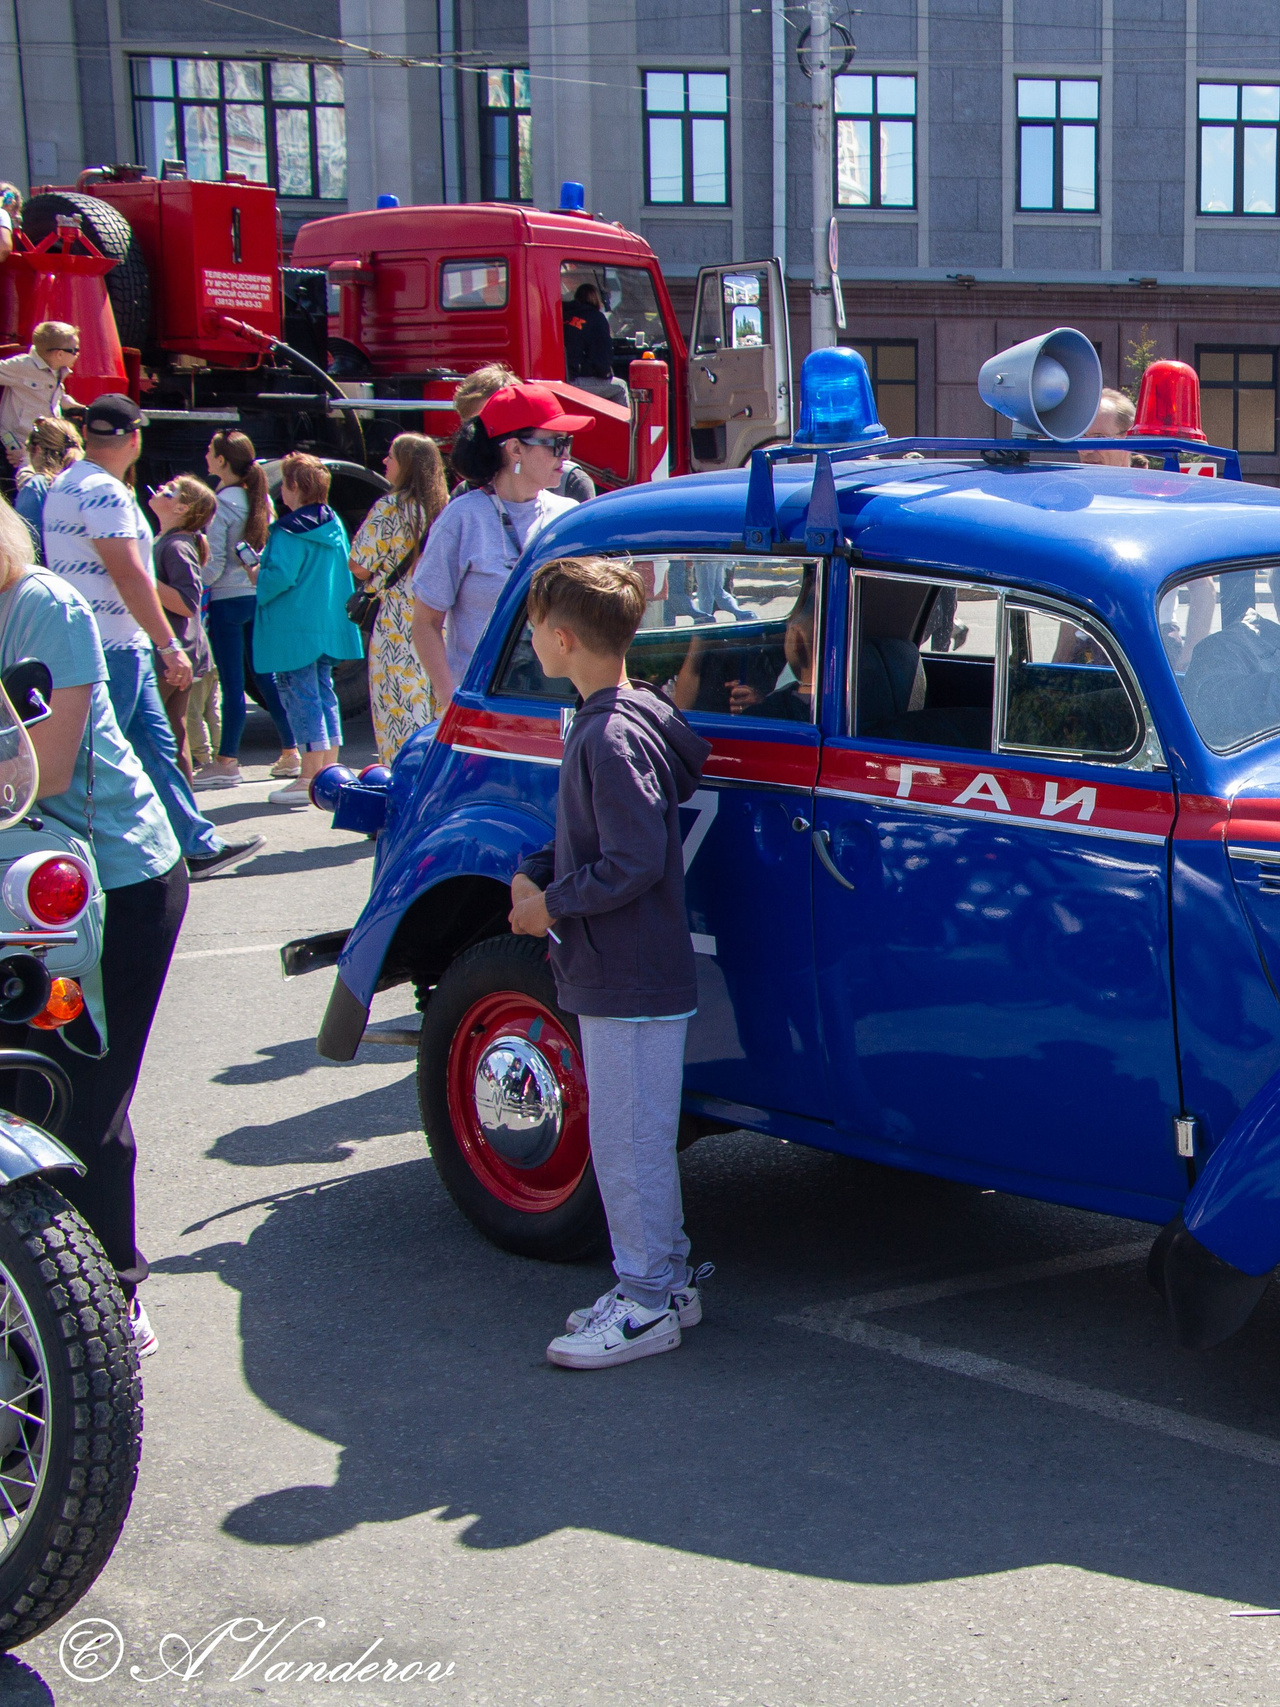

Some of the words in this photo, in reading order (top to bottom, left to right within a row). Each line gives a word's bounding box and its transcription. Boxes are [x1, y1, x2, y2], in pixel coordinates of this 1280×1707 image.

[204, 270, 237, 280] ТЕЛЕФОН
[238, 273, 272, 284] ДОВЕРИЯ
[205, 279, 214, 287] ГУ
[214, 280, 230, 288] МЧС
[231, 281, 259, 291] РОССИИ
[260, 284, 271, 292] ПО
[207, 288, 236, 297] ОМСКОЙ
[237, 291, 270, 300] ОБЛАСТИ
[896, 763, 1097, 821] ГАИ
